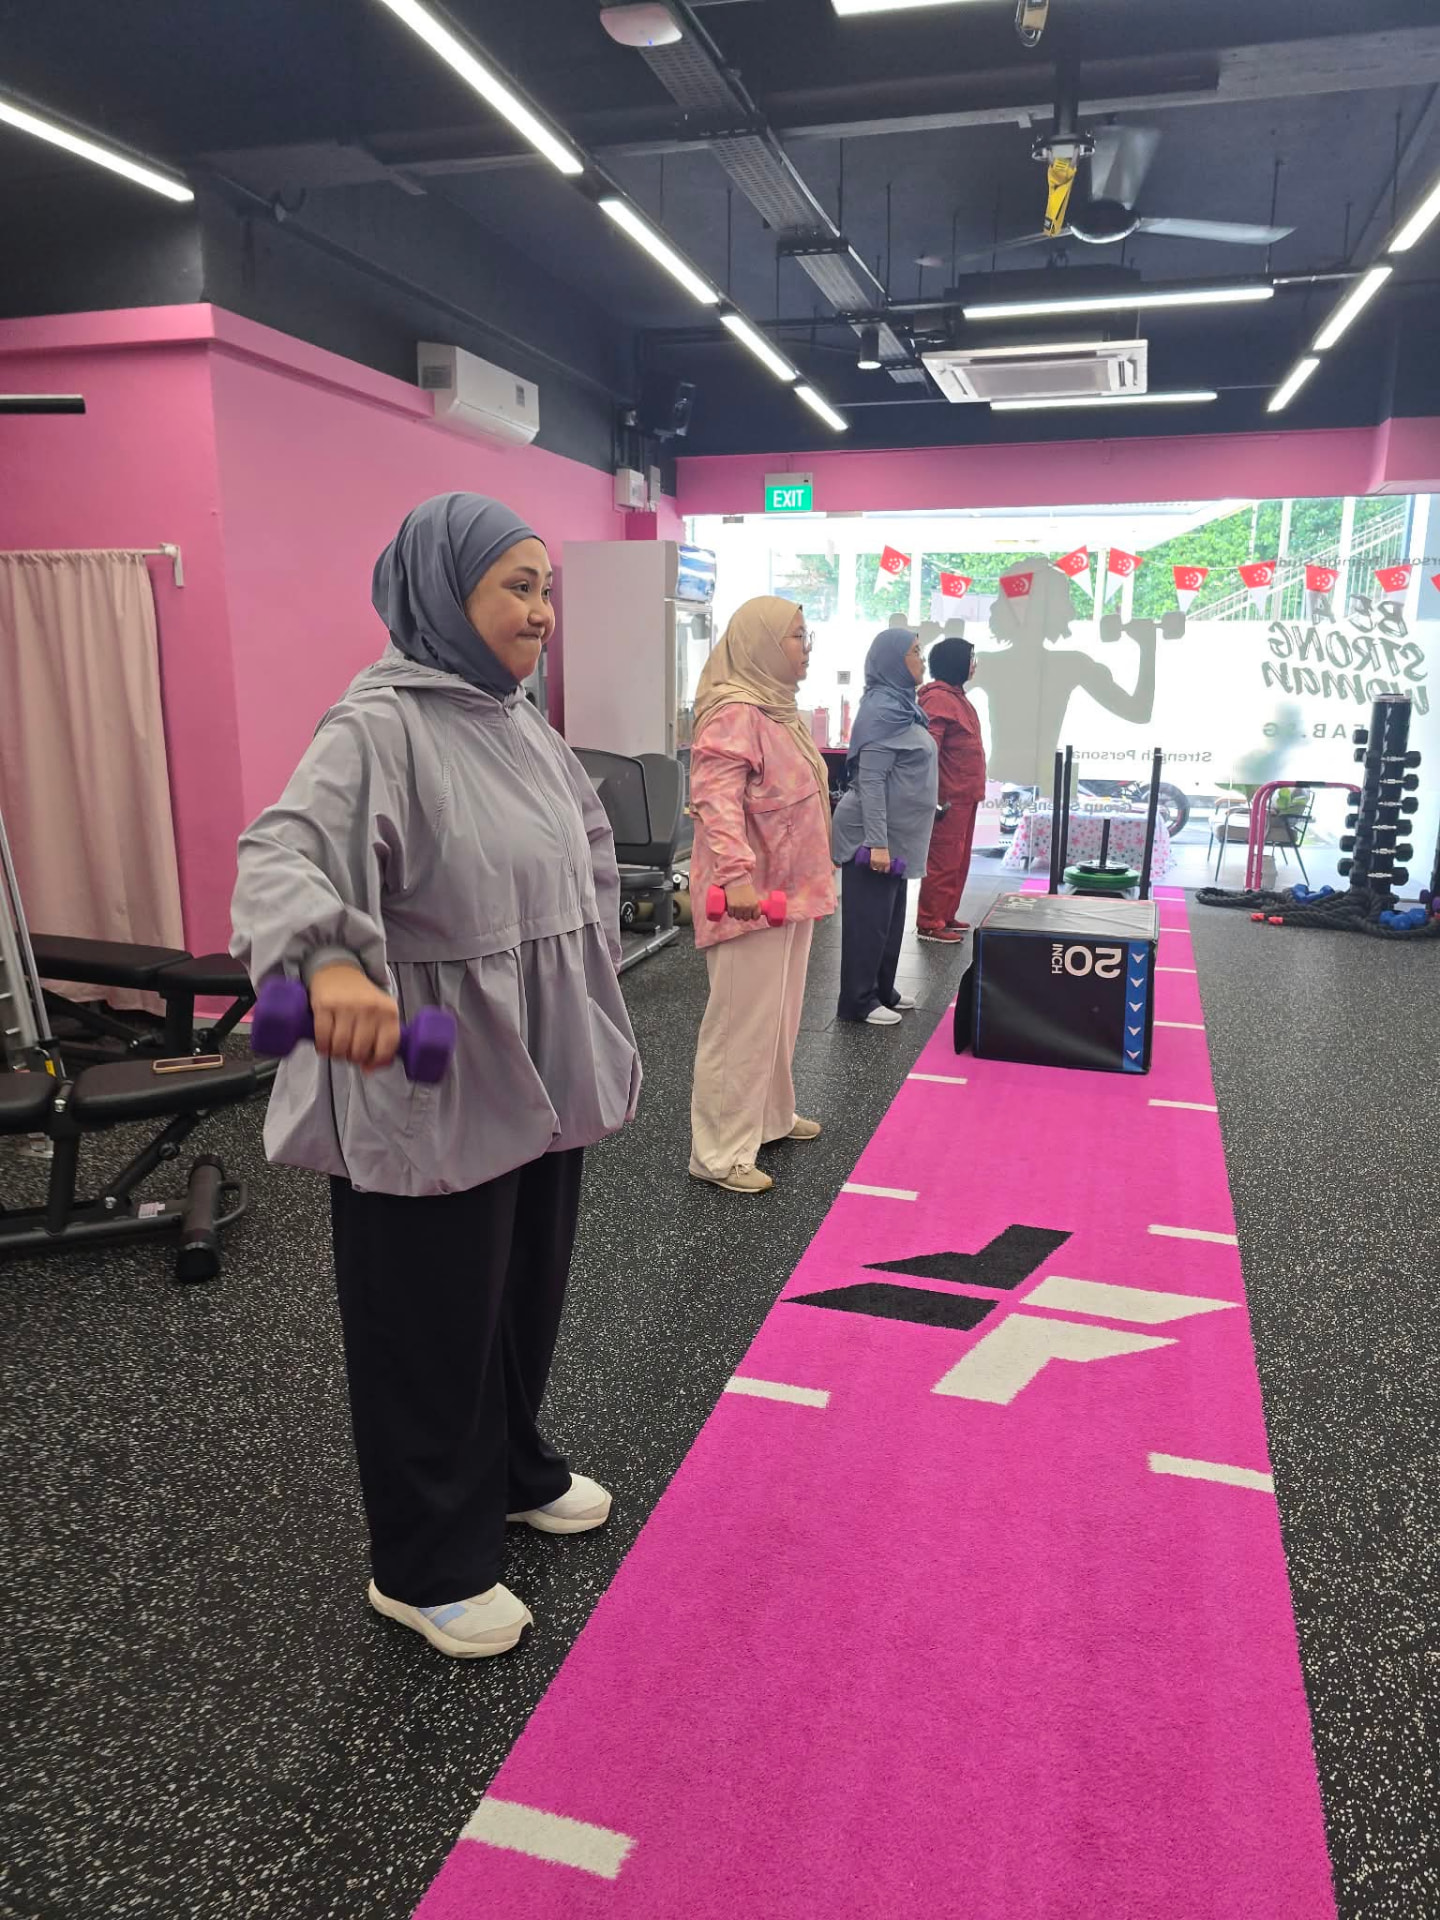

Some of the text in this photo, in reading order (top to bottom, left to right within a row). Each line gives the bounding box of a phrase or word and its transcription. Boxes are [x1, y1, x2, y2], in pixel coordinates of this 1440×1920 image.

[773, 489, 804, 508] EXIT
[1051, 943, 1064, 975] INCH
[1064, 945, 1123, 979] 20
